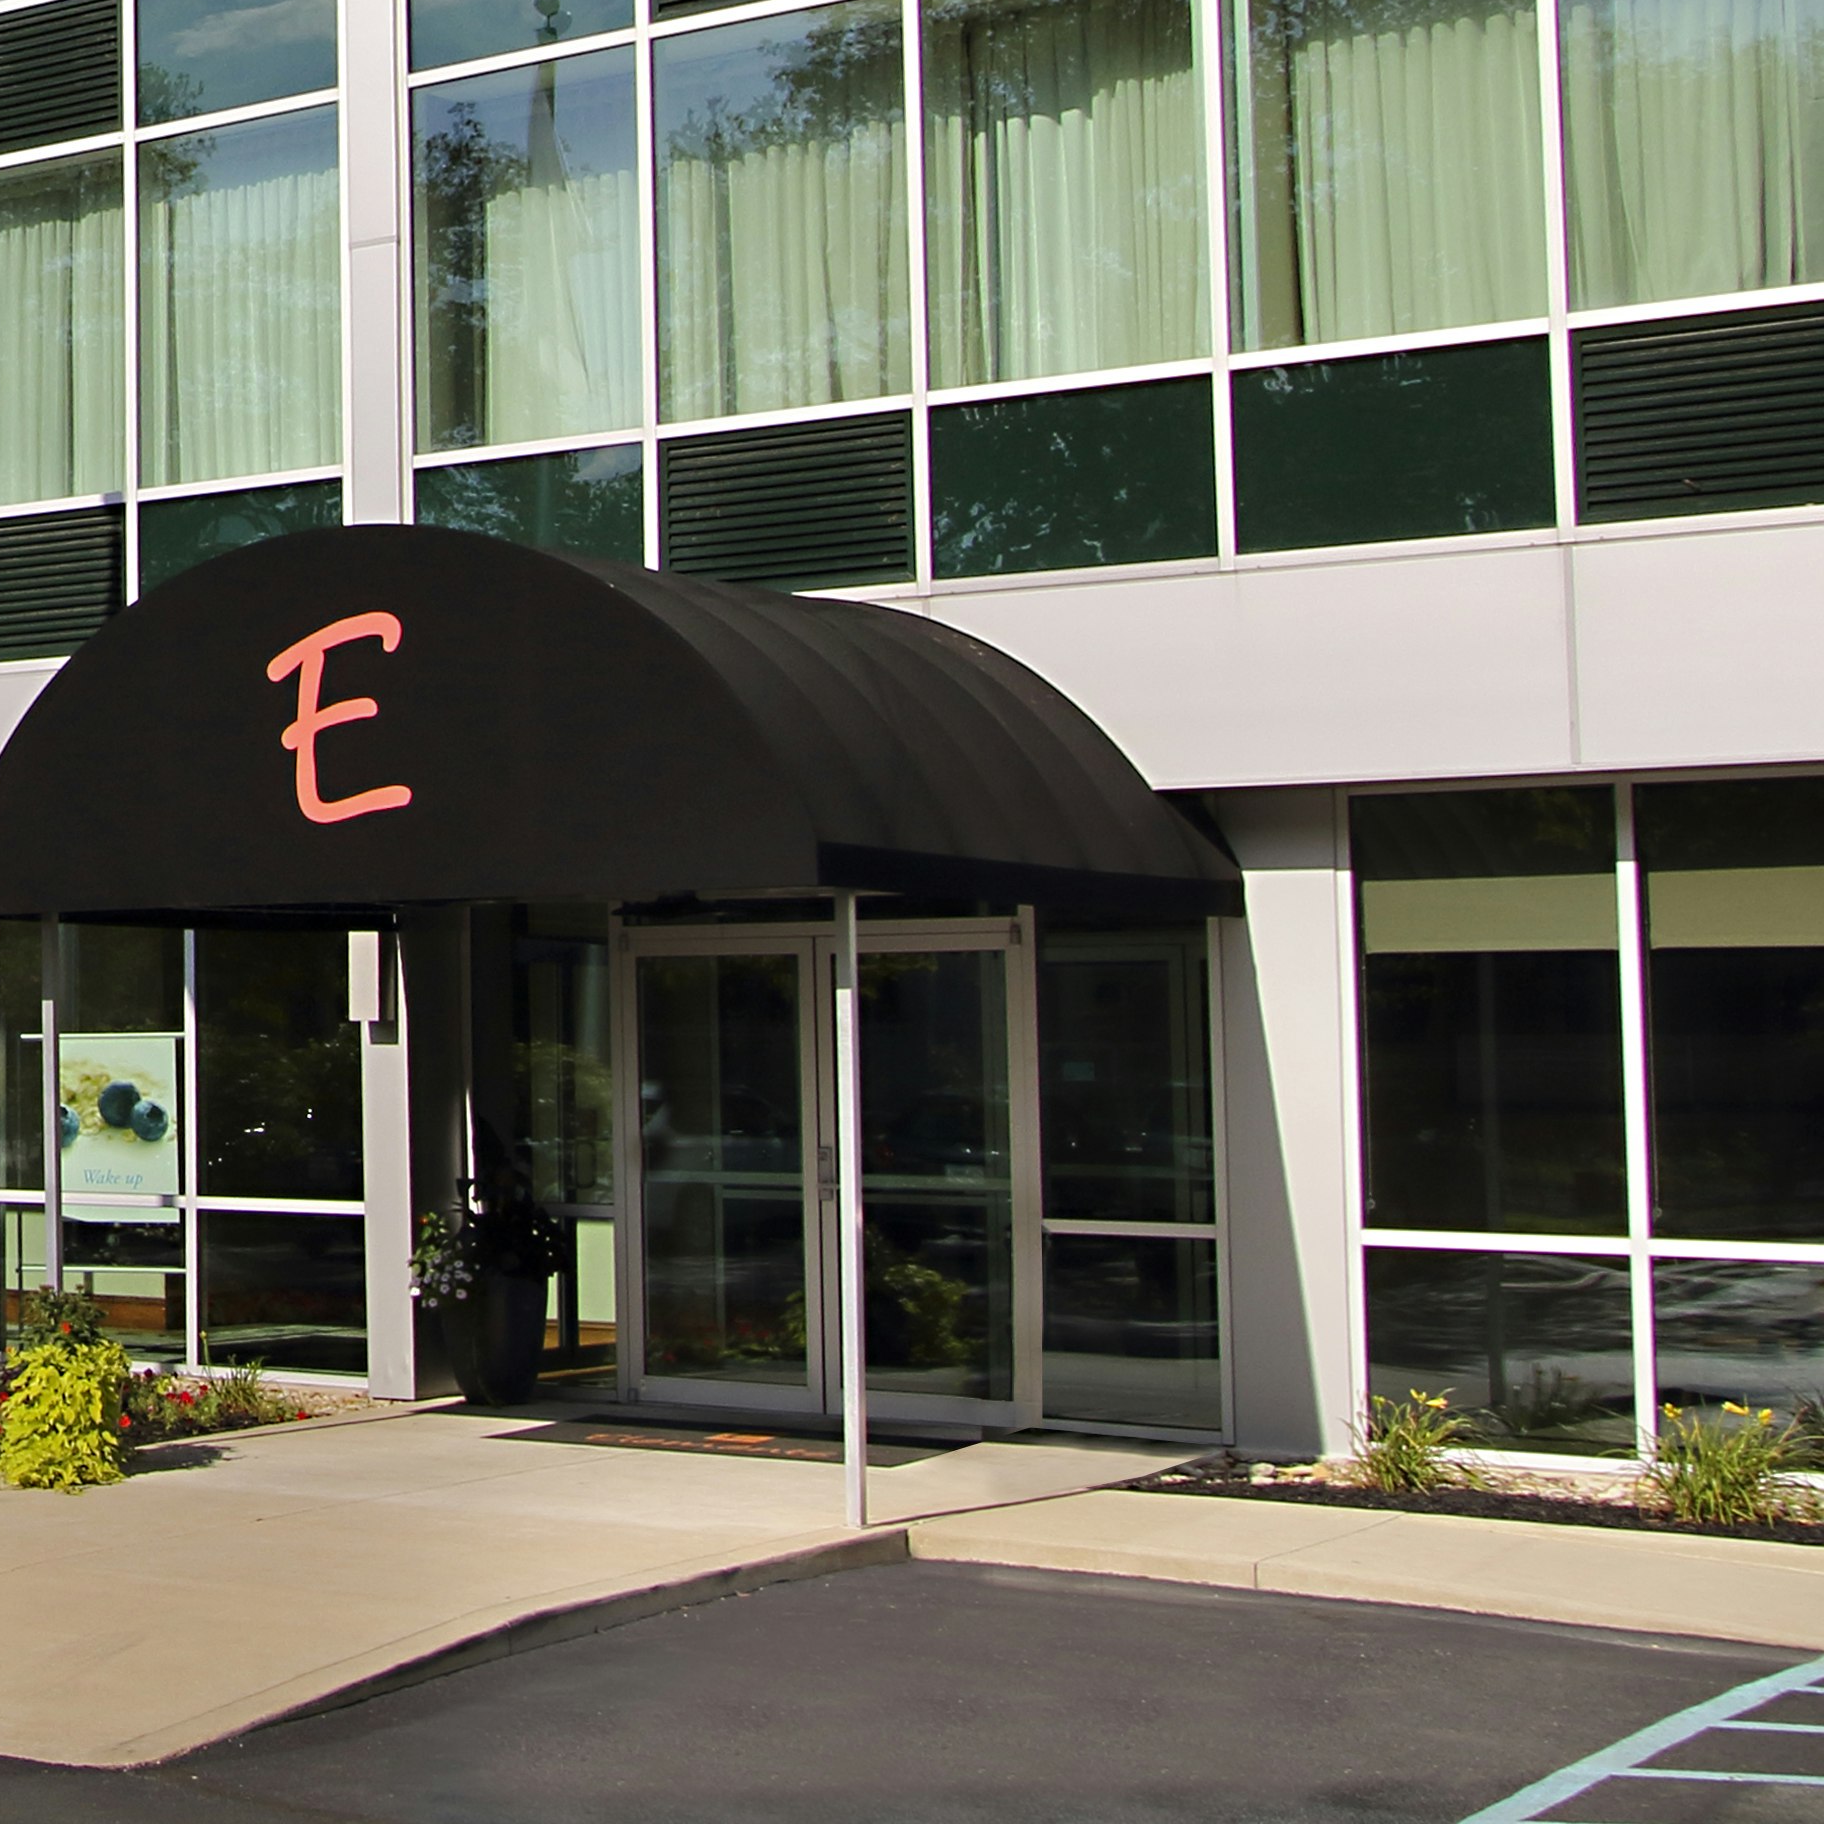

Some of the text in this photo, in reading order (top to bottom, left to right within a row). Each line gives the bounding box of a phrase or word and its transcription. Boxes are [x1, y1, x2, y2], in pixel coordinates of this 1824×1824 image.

[266, 610, 413, 824] E
[83, 1168, 144, 1190] Wake up
